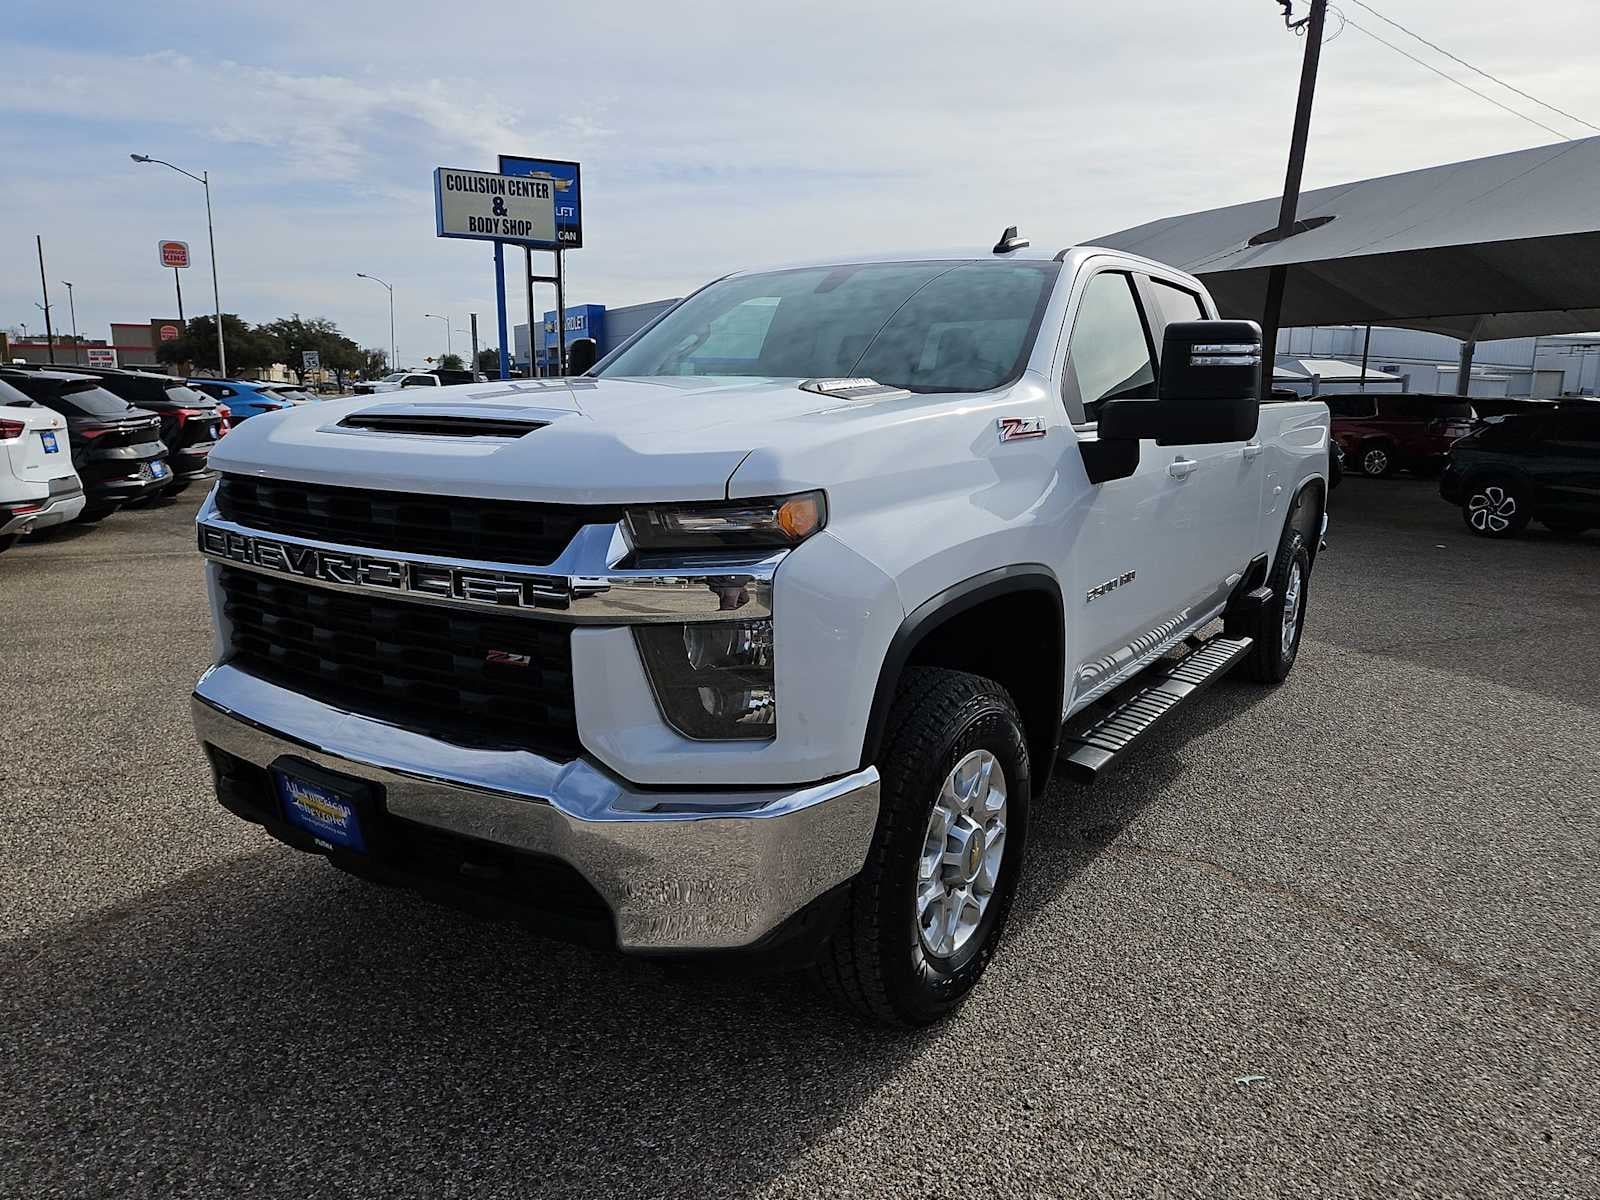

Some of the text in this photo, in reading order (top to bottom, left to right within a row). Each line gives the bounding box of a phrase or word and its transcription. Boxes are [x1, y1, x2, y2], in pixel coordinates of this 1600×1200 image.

[446, 174, 549, 199] COLLISION CENTER
[492, 196, 508, 217] &
[469, 216, 532, 236] BODY SHOP
[164, 254, 187, 262] KING
[306, 360, 318, 368] 35
[998, 416, 1047, 441] Z71
[203, 527, 571, 609] CHEVROLET
